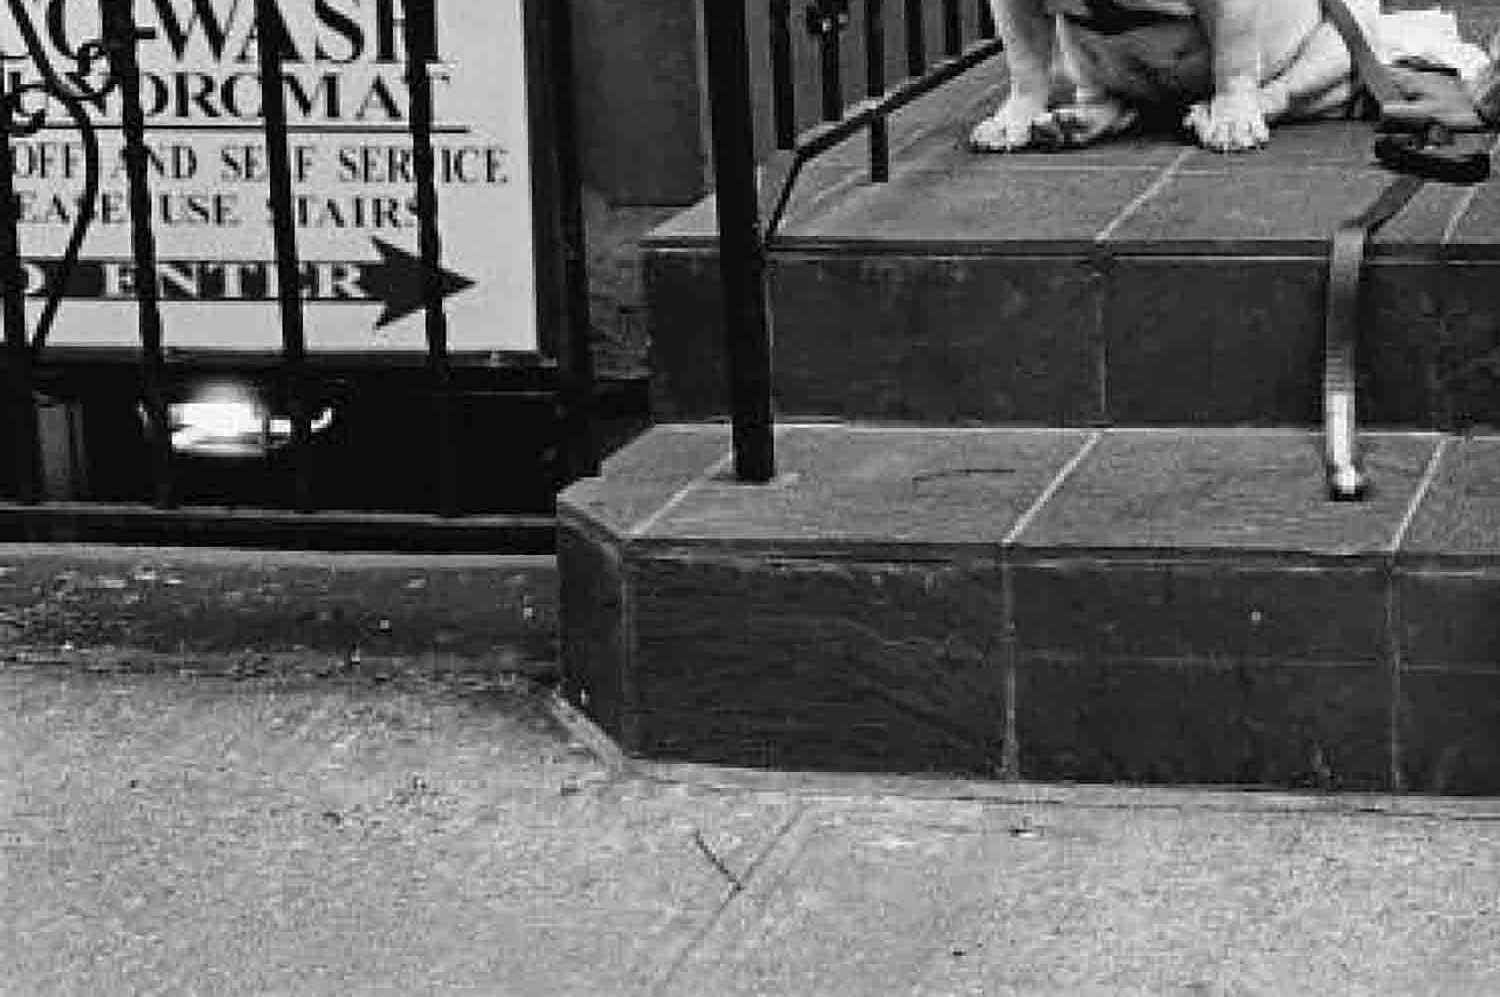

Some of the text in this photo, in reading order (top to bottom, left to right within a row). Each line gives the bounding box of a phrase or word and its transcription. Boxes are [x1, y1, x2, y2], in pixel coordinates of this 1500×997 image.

[220, 145, 314, 182] SEF
[338, 145, 508, 184] SERICE
[13, 191, 421, 228] EAE USE TAIRS
